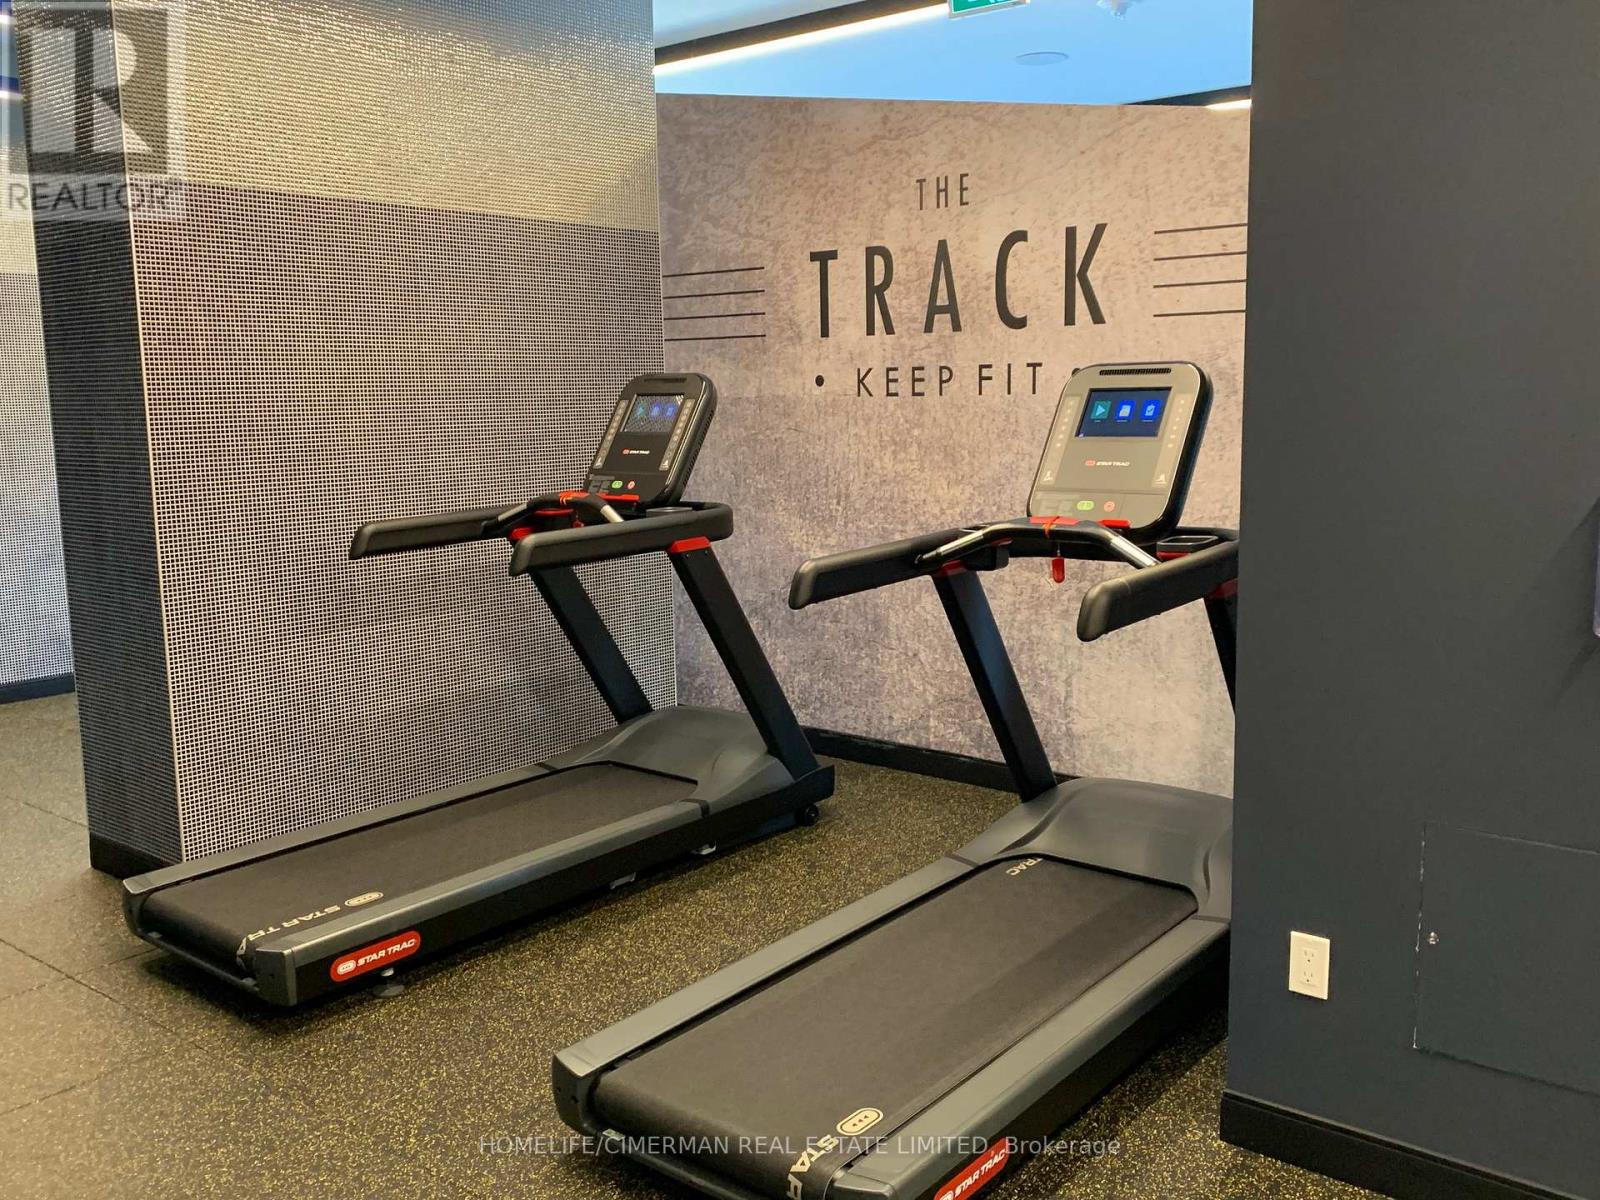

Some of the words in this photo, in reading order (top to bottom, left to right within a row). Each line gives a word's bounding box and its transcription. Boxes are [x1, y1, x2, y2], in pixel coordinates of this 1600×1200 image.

[915, 173, 969, 210] THE
[809, 222, 1109, 339] TRACK
[856, 365, 954, 398] KEEP
[978, 362, 1043, 396] FIT
[282, 904, 341, 928] STAR
[356, 949, 386, 967] STAR
[386, 938, 416, 956] TRAC
[954, 1169, 981, 1198] STAR
[980, 1148, 1006, 1176] TRAC
